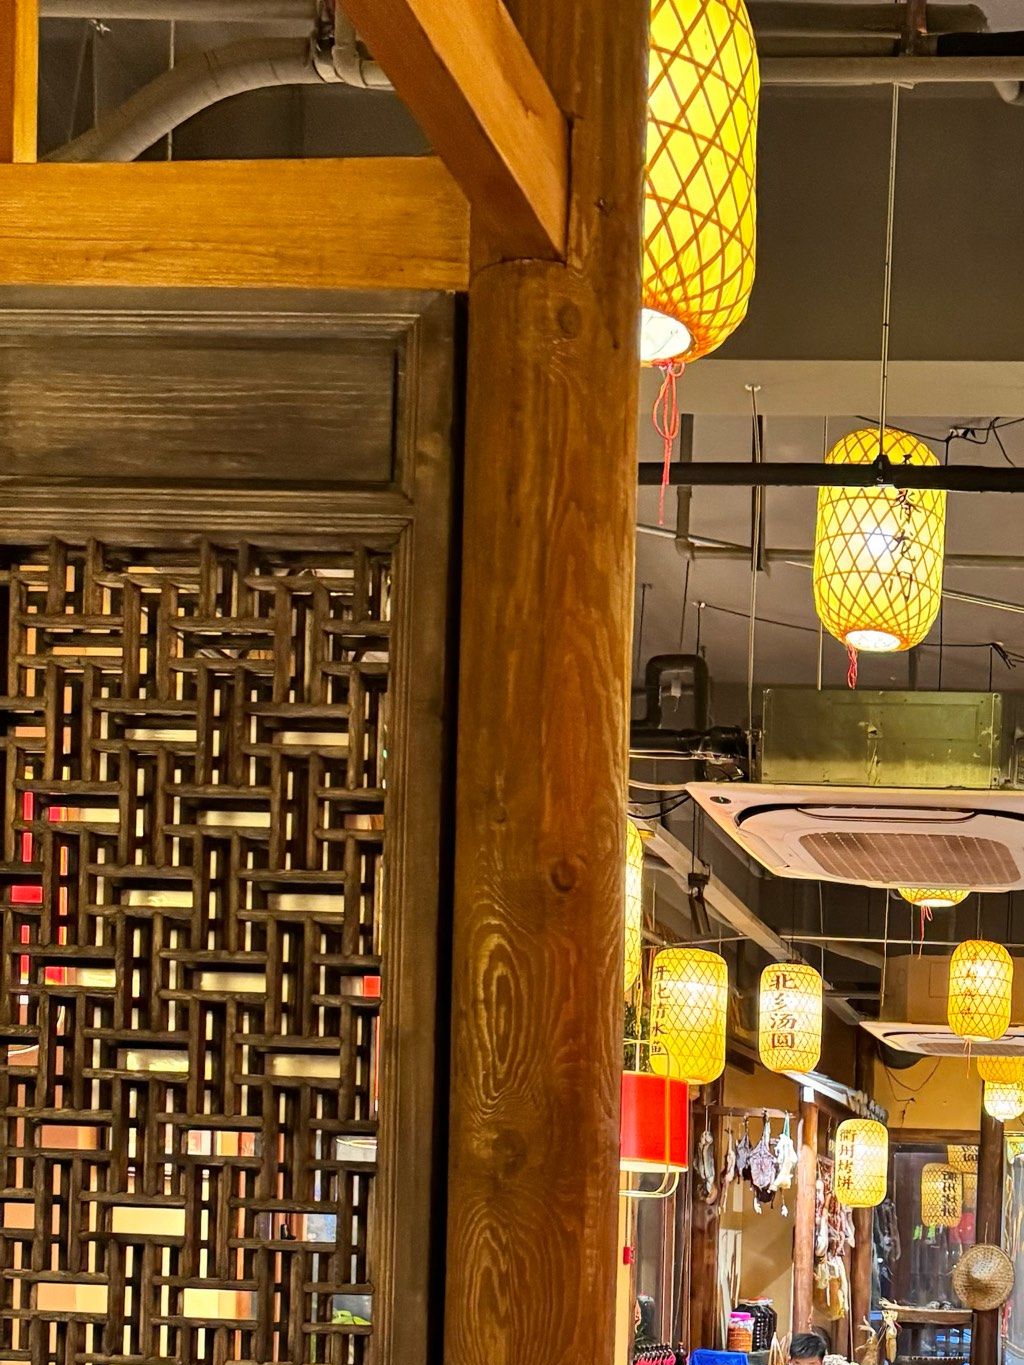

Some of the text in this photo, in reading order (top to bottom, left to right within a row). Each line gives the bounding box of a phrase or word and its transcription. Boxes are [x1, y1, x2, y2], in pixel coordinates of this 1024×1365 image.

[889, 454, 922, 602] 脊龙门
[769, 973, 799, 1049] 北乡汤圆
